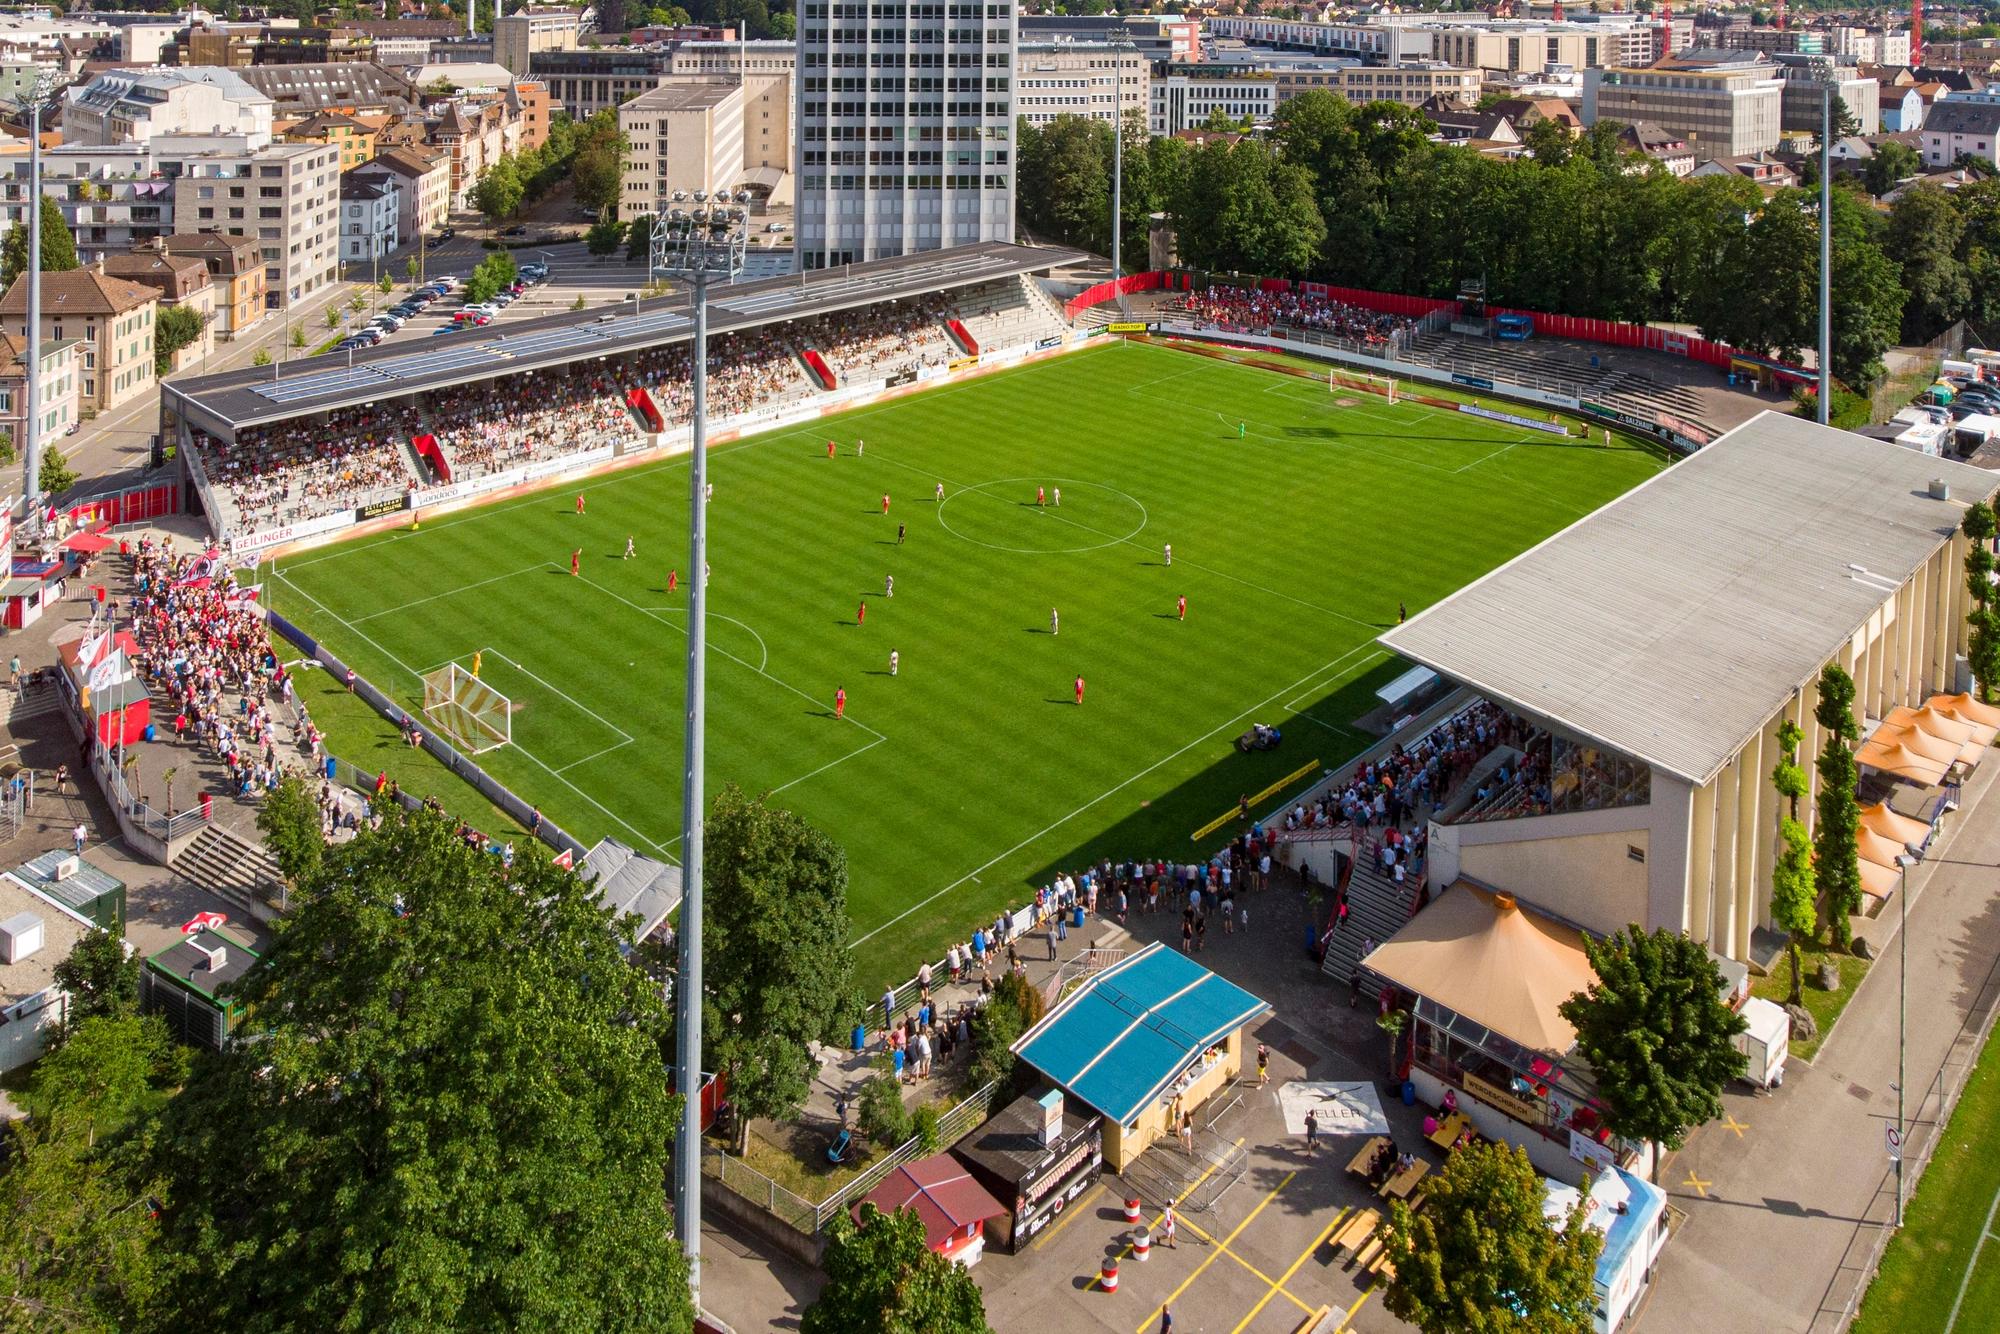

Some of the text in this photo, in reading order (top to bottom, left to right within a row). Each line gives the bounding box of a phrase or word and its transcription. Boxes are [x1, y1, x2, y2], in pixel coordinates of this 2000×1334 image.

[1625, 416, 1654, 431] SALZHAUS
[236, 528, 293, 550] GEILINGER
[1431, 828, 1439, 840] A
